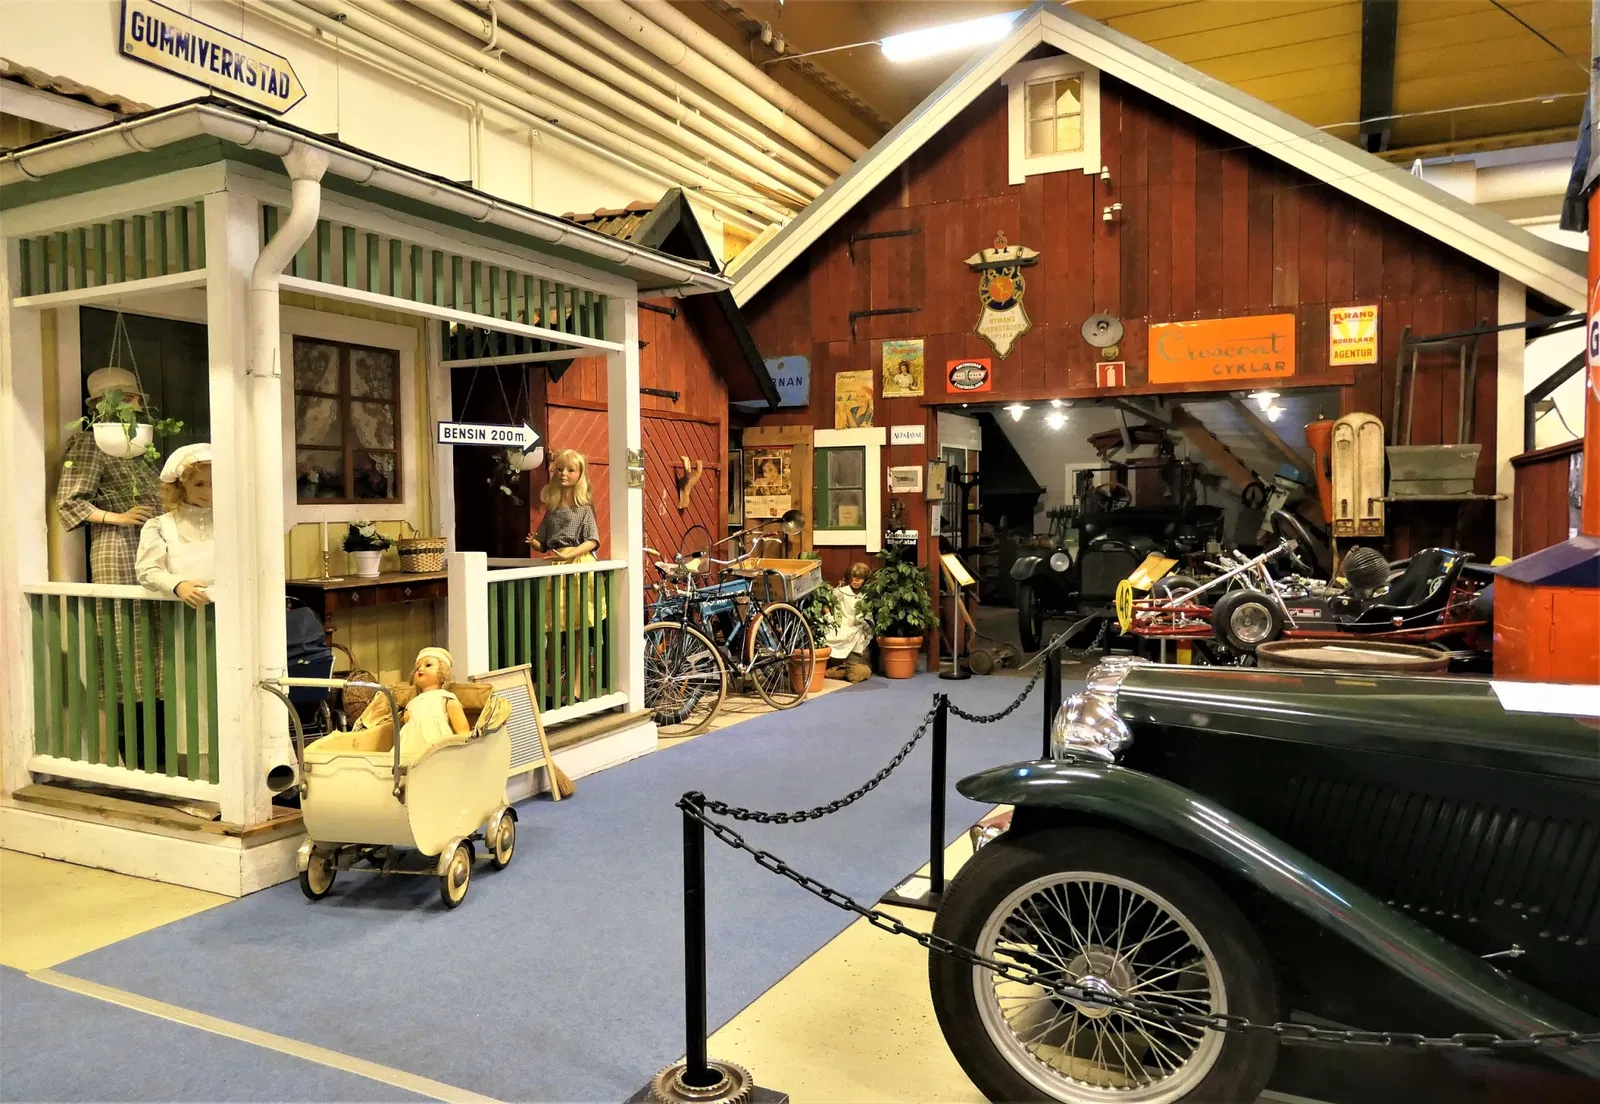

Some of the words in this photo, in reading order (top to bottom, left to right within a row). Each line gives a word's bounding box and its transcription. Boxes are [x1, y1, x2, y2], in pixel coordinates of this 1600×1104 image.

[131, 11, 290, 99] GUMMIVERKSTAD
[981, 266, 1022, 304] HERMES
[1158, 330, 1286, 362] Crescent
[1334, 348, 1372, 358] AGENTUR
[1212, 361, 1286, 375] CYKLAR
[444, 427, 486, 440] BENSIN
[1120, 586, 1130, 620] 46
